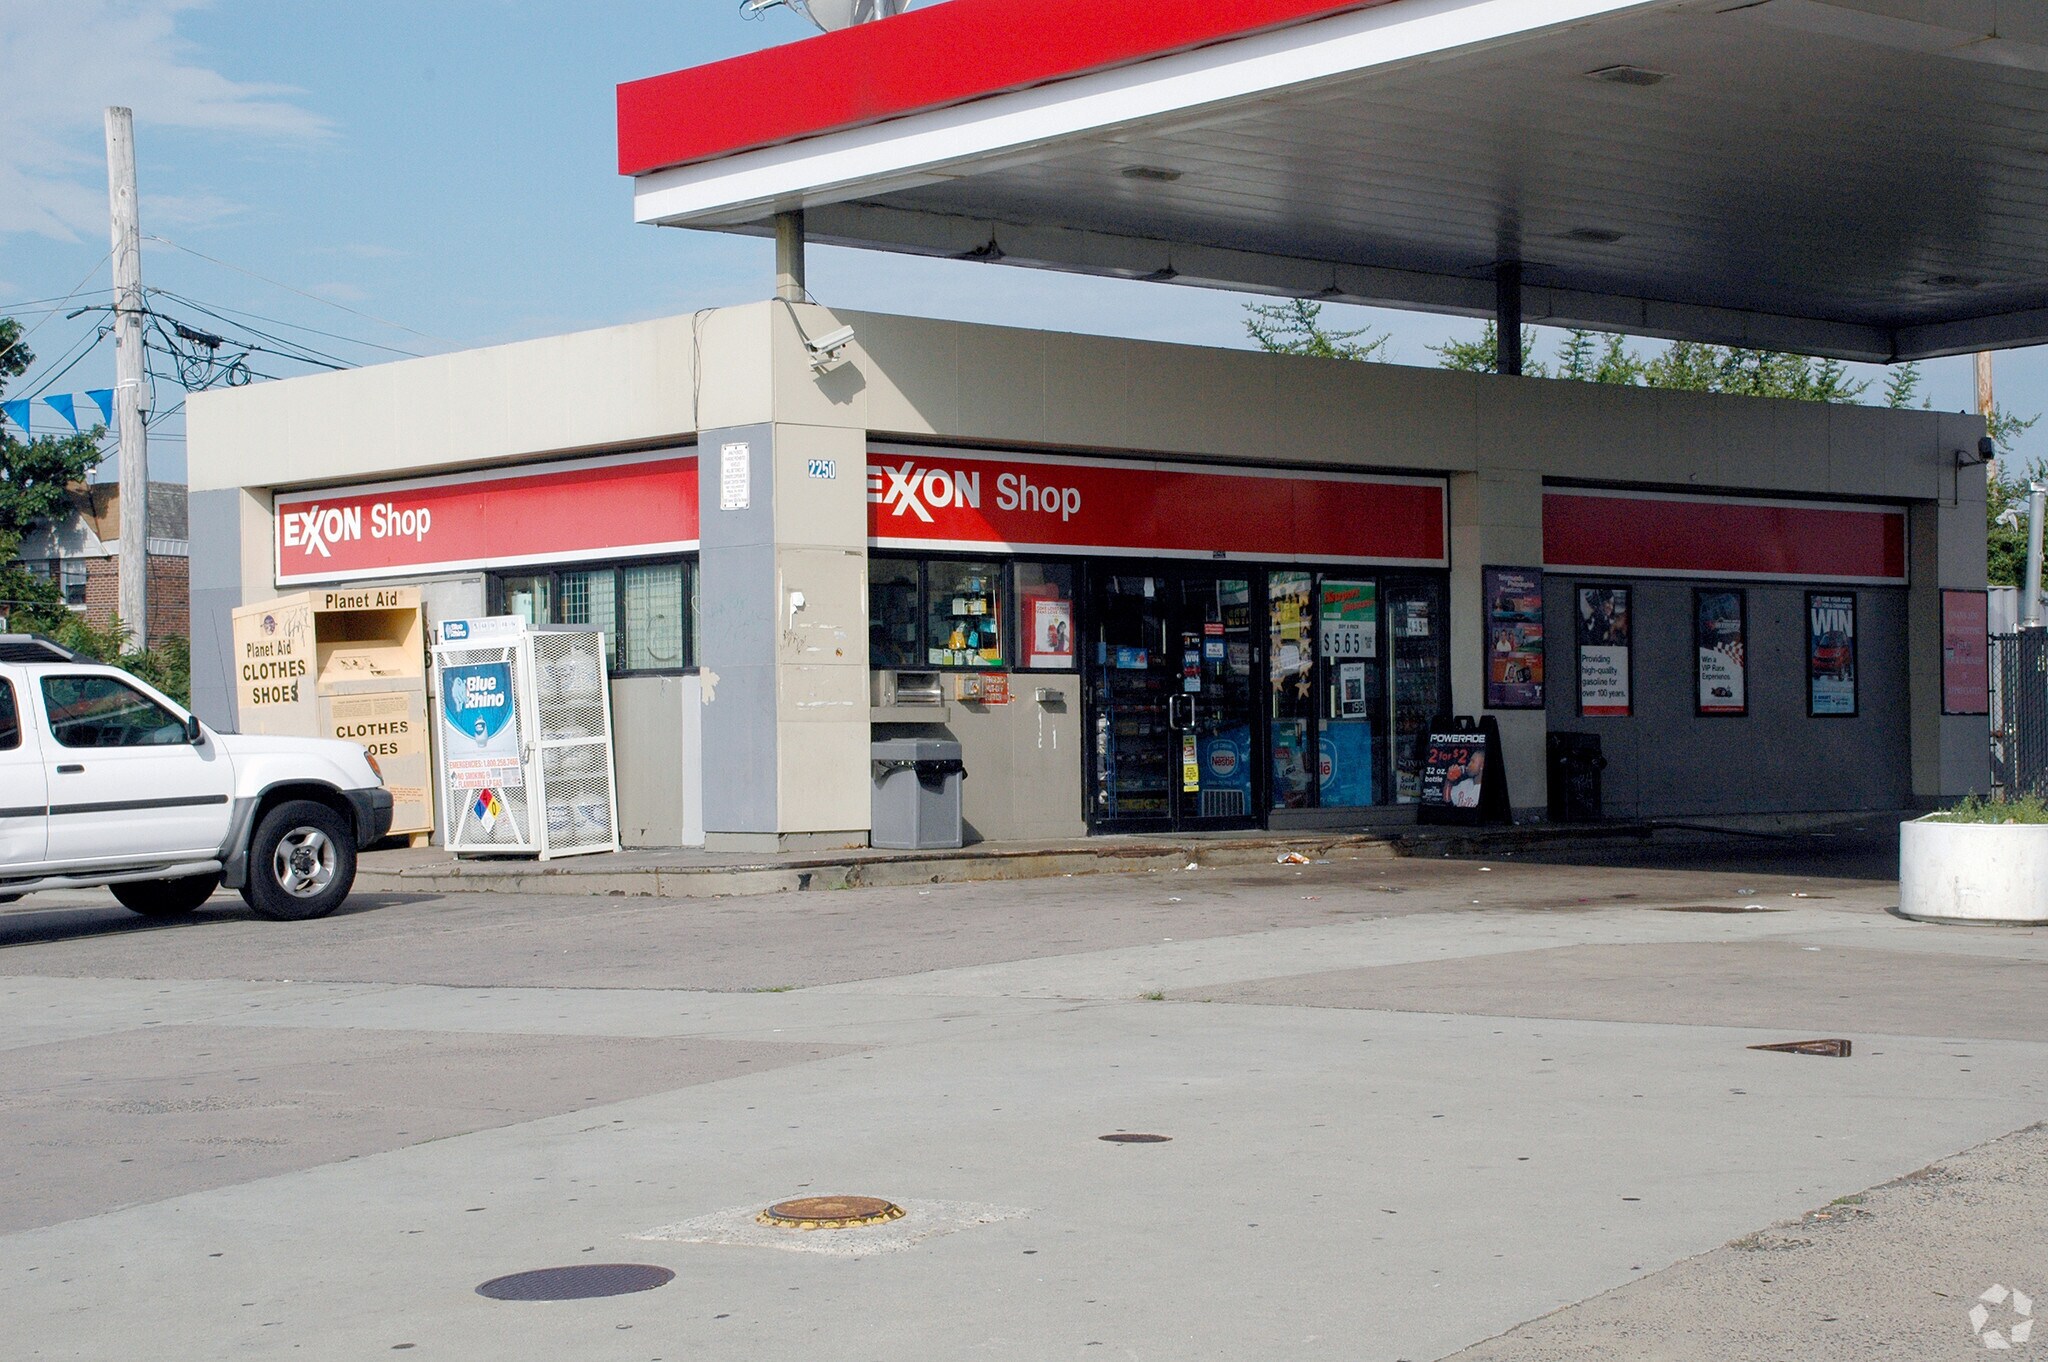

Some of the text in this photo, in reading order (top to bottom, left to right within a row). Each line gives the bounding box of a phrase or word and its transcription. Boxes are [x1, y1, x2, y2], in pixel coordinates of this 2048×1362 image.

[809, 459, 836, 479] 2250
[867, 461, 1081, 522] EXXON Shop
[284, 503, 431, 557] EXXON Shop
[325, 591, 397, 609] Planet Aid
[1811, 608, 1853, 637] WIN
[247, 640, 291, 658] Planet Aid
[1184, 653, 1200, 663] WIN
[1582, 655, 1610, 664] Providing
[243, 659, 306, 681] CLOTHES
[1582, 667, 1617, 676] high-quality
[467, 675, 496, 691] Blue
[1582, 678, 1608, 687] gasoline
[253, 685, 299, 704] SHOES
[465, 690, 504, 709] Rhino
[1598, 689, 1607, 697] 100
[1609, 690, 1625, 700] years.
[336, 721, 409, 738] CLOTHES
[1430, 734, 1486, 743] POWERADE
[367, 742, 398, 756] OES
[1428, 747, 1438, 764] 2
[1439, 751, 1452, 761] for
[1453, 747, 1469, 764] $2
[458, 780, 486, 788] FLAMMABLE
[492, 801, 496, 816] 0
